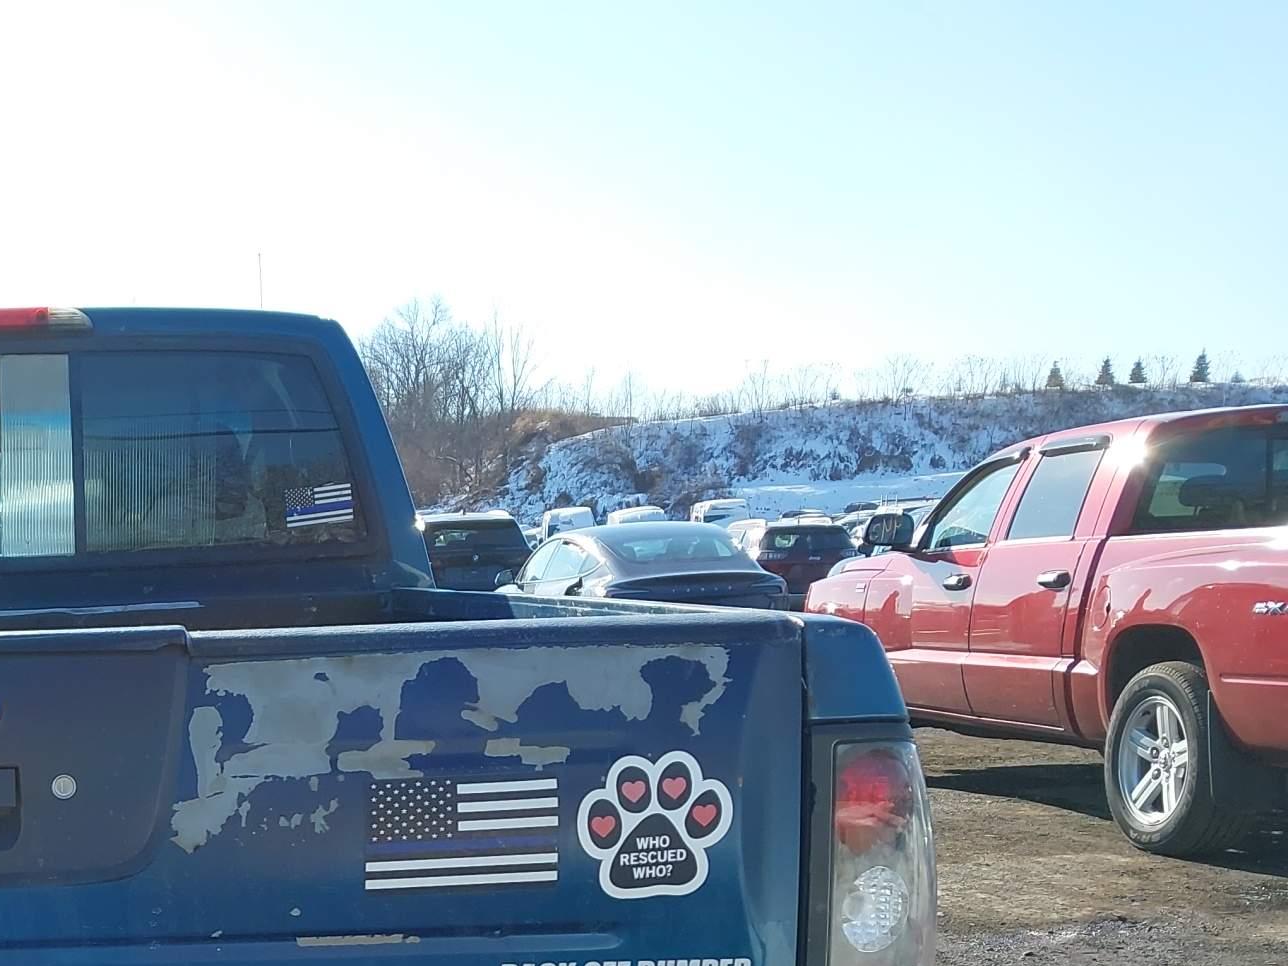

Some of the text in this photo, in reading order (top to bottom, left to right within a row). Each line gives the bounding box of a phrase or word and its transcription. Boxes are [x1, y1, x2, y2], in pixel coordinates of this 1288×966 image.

[636, 835, 671, 850] WHO
[620, 848, 687, 867] RESCUED
[632, 864, 673, 880] WHO?
